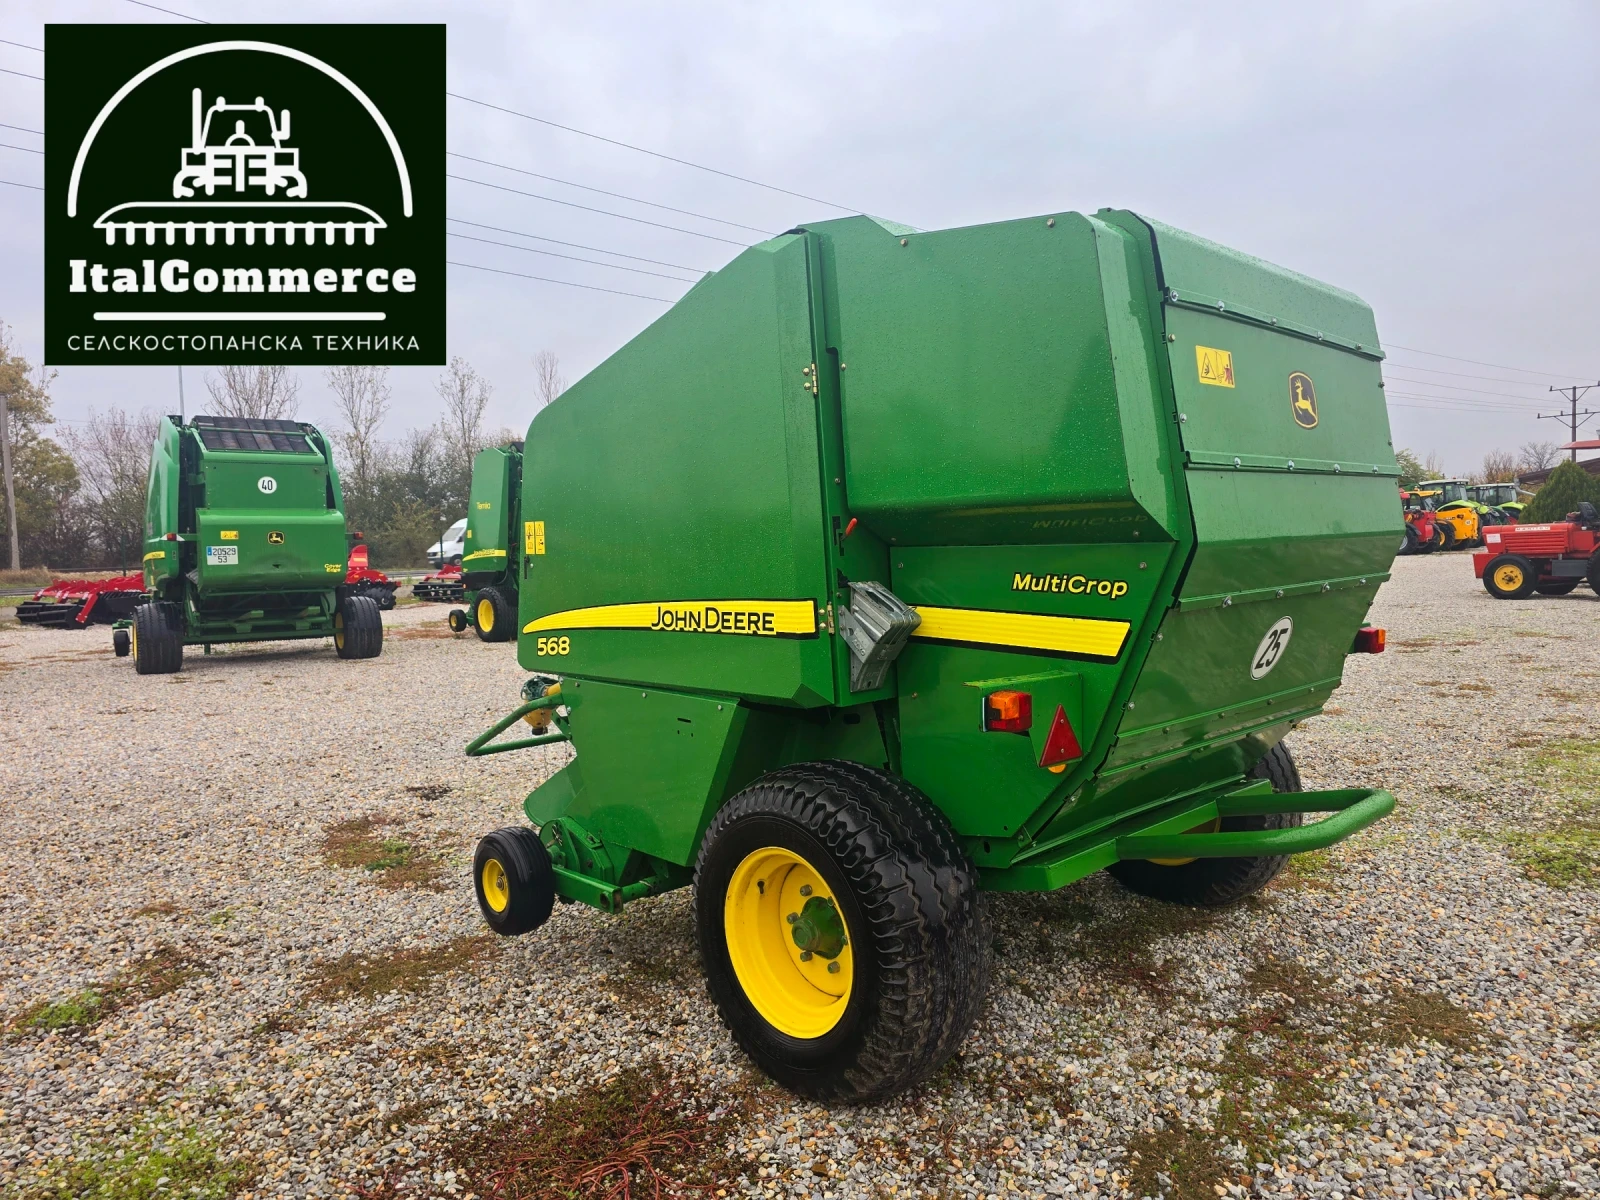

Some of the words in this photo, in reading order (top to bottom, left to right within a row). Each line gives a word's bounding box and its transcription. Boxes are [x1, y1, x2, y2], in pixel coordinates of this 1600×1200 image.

[261, 479, 273, 491] 40
[212, 547, 237, 556] 20529
[217, 555, 228, 564] 53
[1011, 572, 1129, 600] MultiCrop
[651, 606, 701, 630] JOHN
[705, 606, 775, 633] DEERE
[536, 635, 571, 656] 568
[1254, 627, 1290, 670] 25
